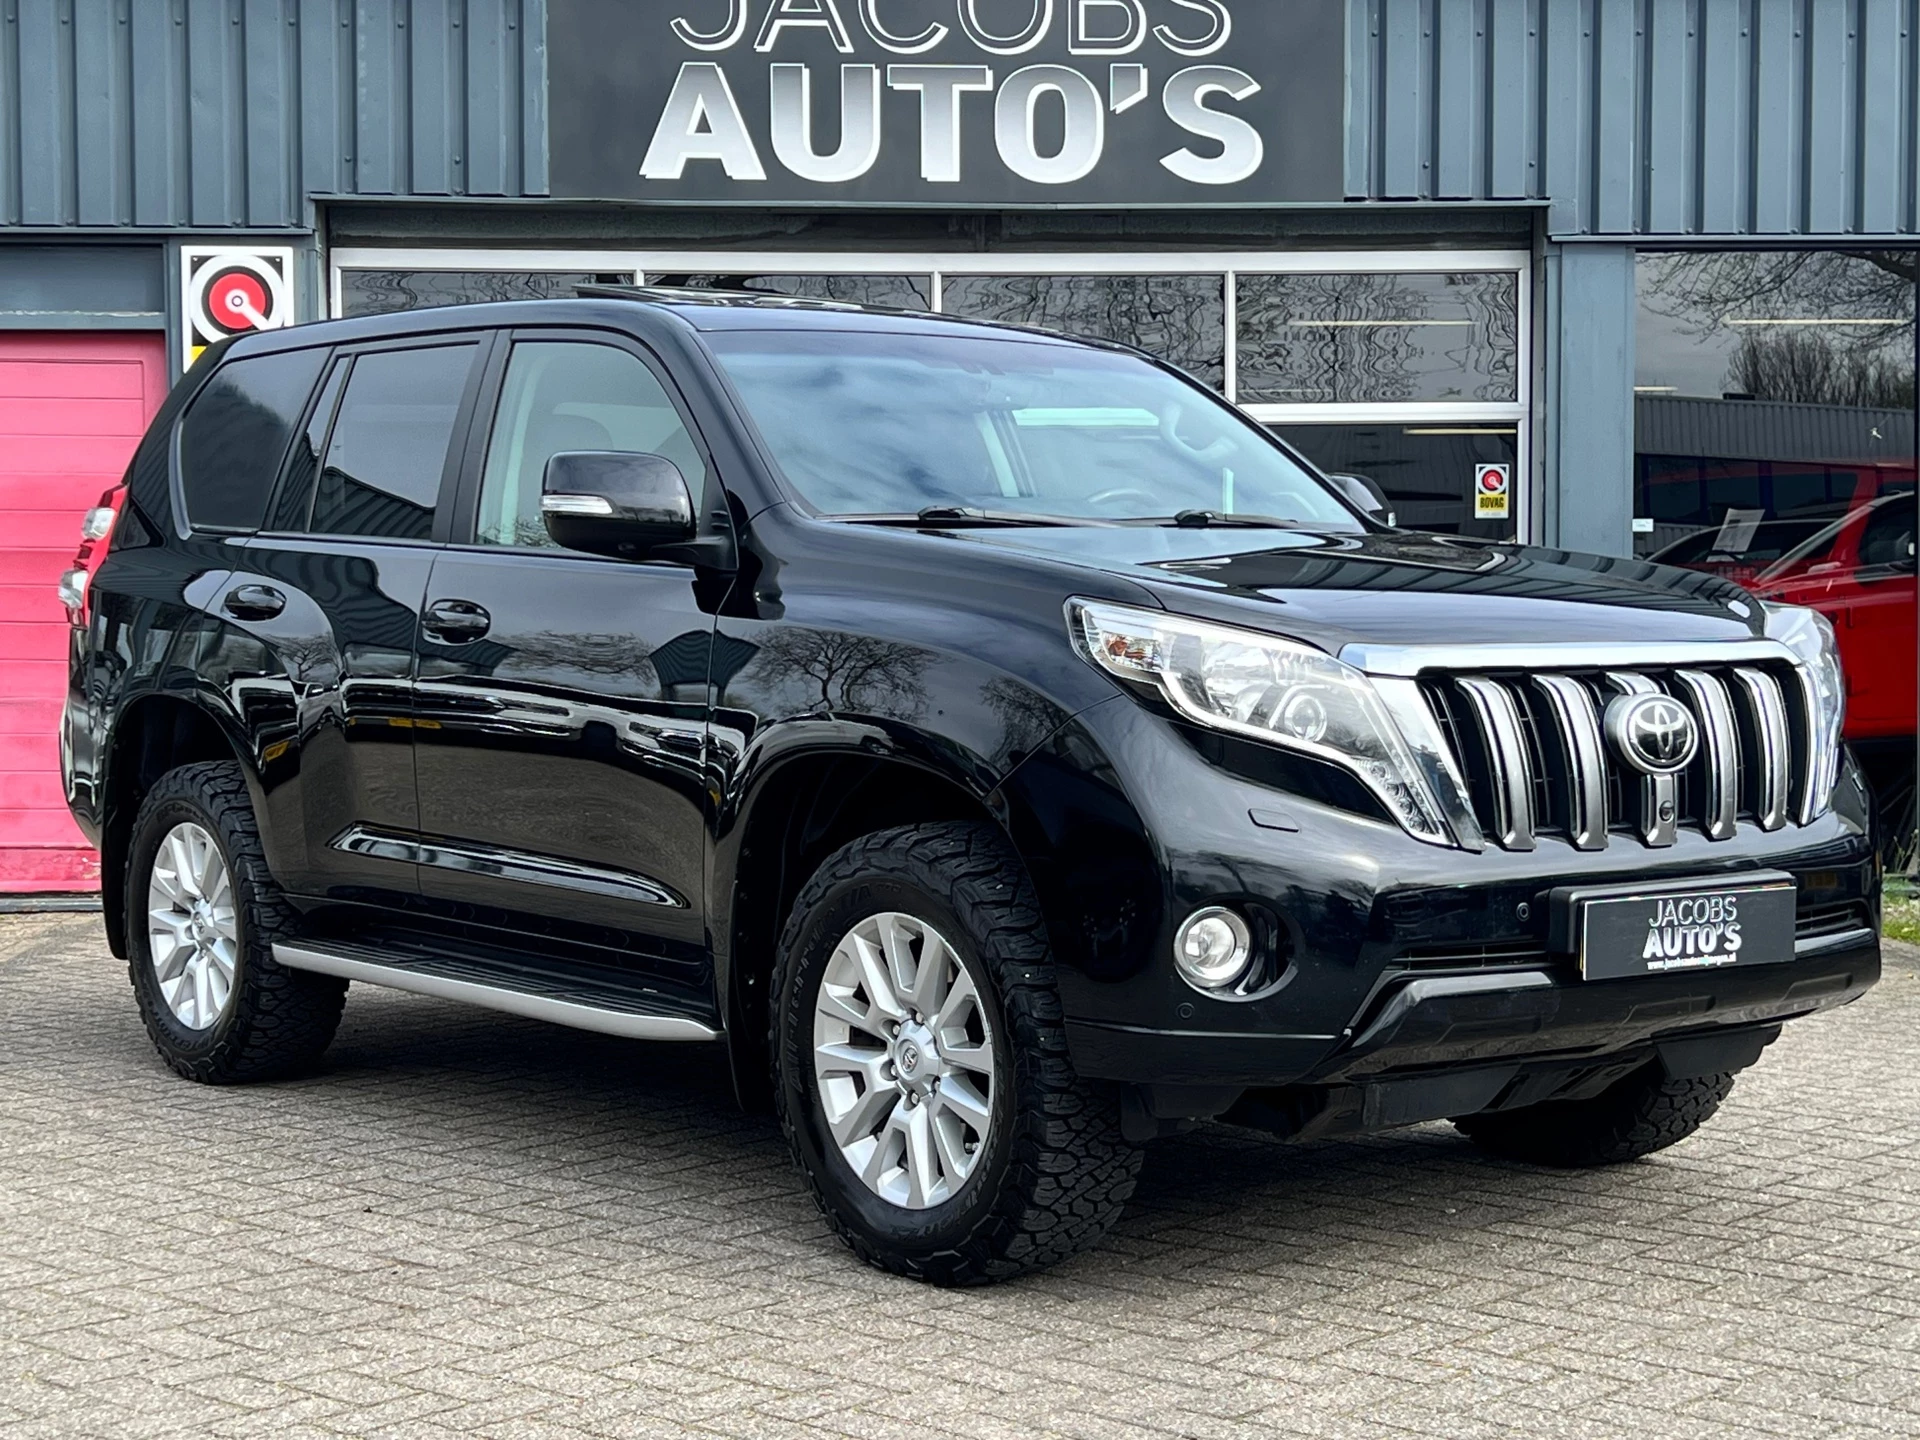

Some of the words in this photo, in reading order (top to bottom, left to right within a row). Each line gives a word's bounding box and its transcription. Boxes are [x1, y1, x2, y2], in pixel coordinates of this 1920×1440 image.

[639, 62, 1264, 185] AUTO'S
[1649, 896, 1738, 927] JACOBS
[1642, 921, 1742, 959] AUTO'S
